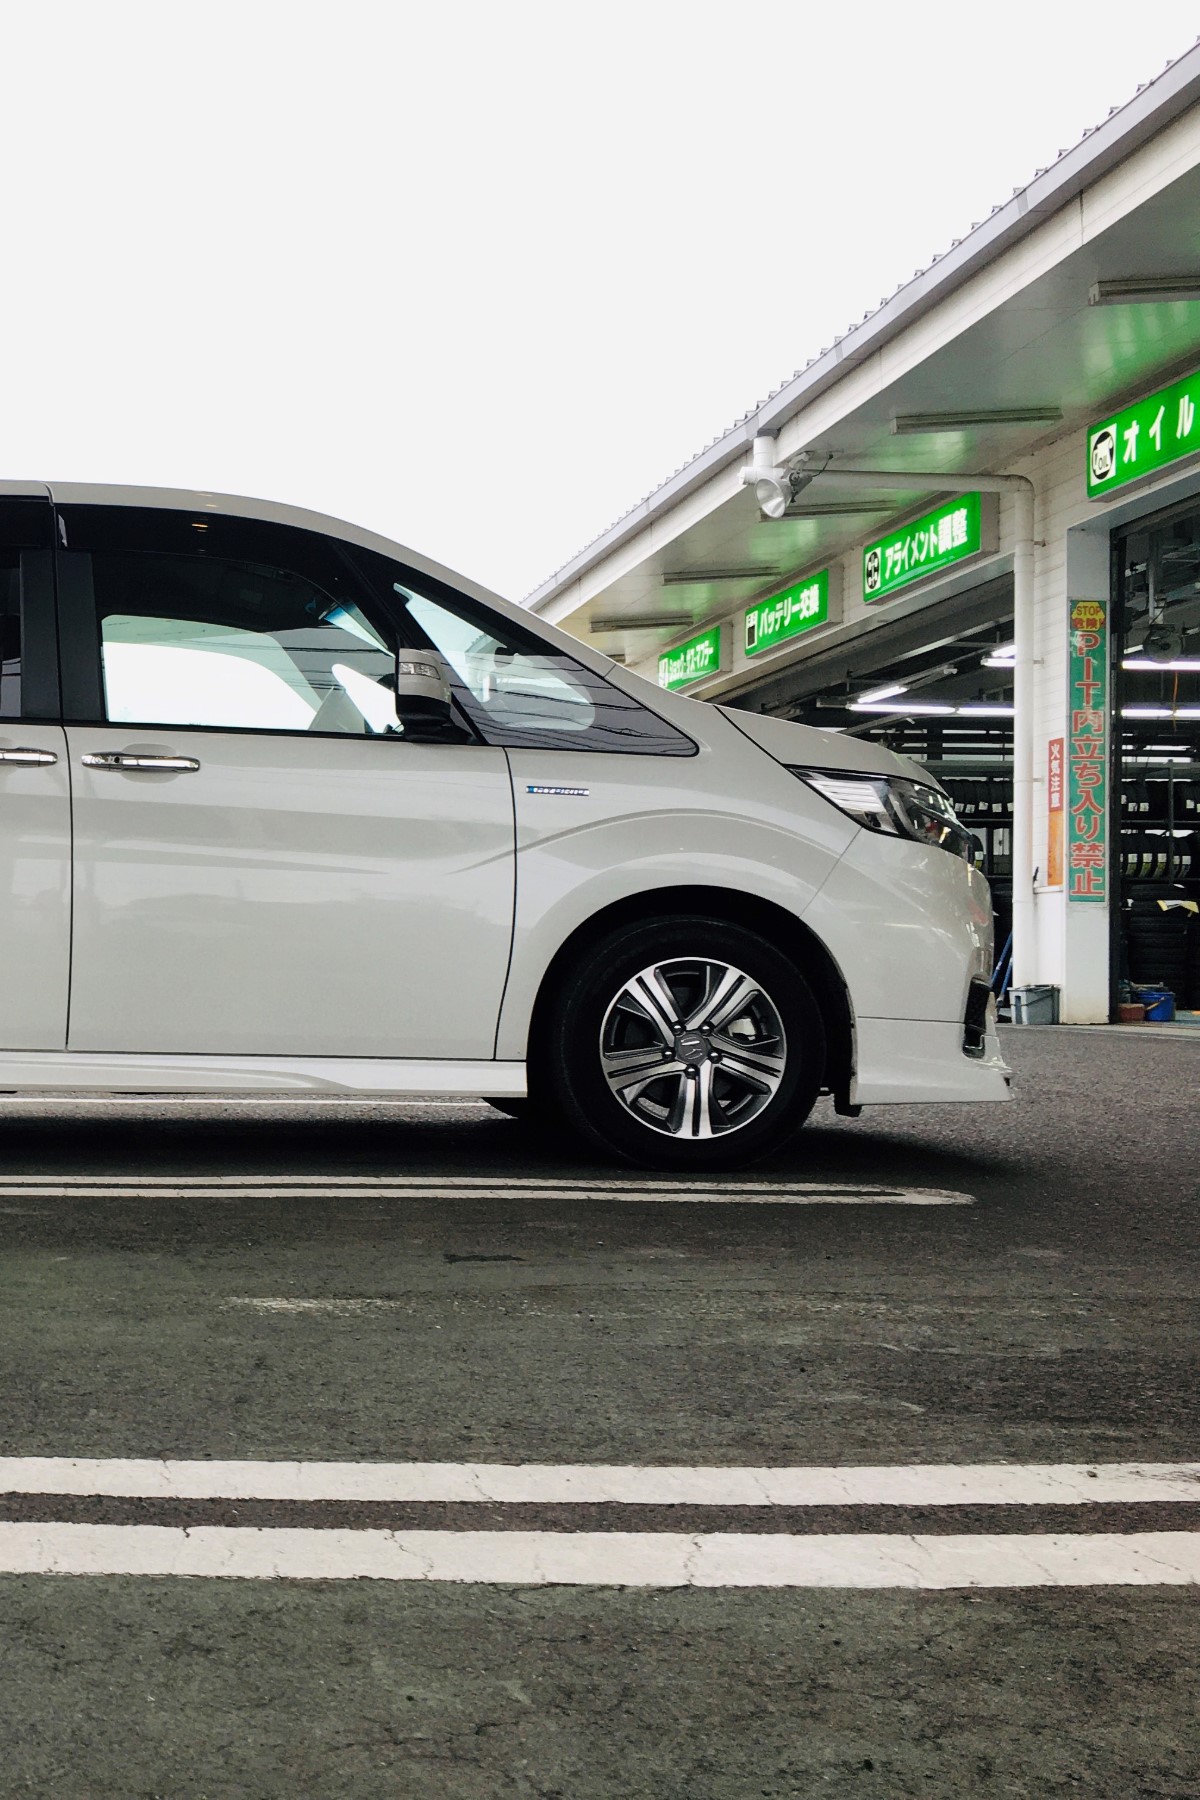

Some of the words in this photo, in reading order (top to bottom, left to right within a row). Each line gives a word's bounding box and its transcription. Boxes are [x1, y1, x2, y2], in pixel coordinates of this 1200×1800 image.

[1123, 394, 1194, 464] オイル
[884, 507, 968, 580] アライメント調整
[759, 583, 820, 637] バッテリー交換
[1076, 606, 1101, 616] STOP
